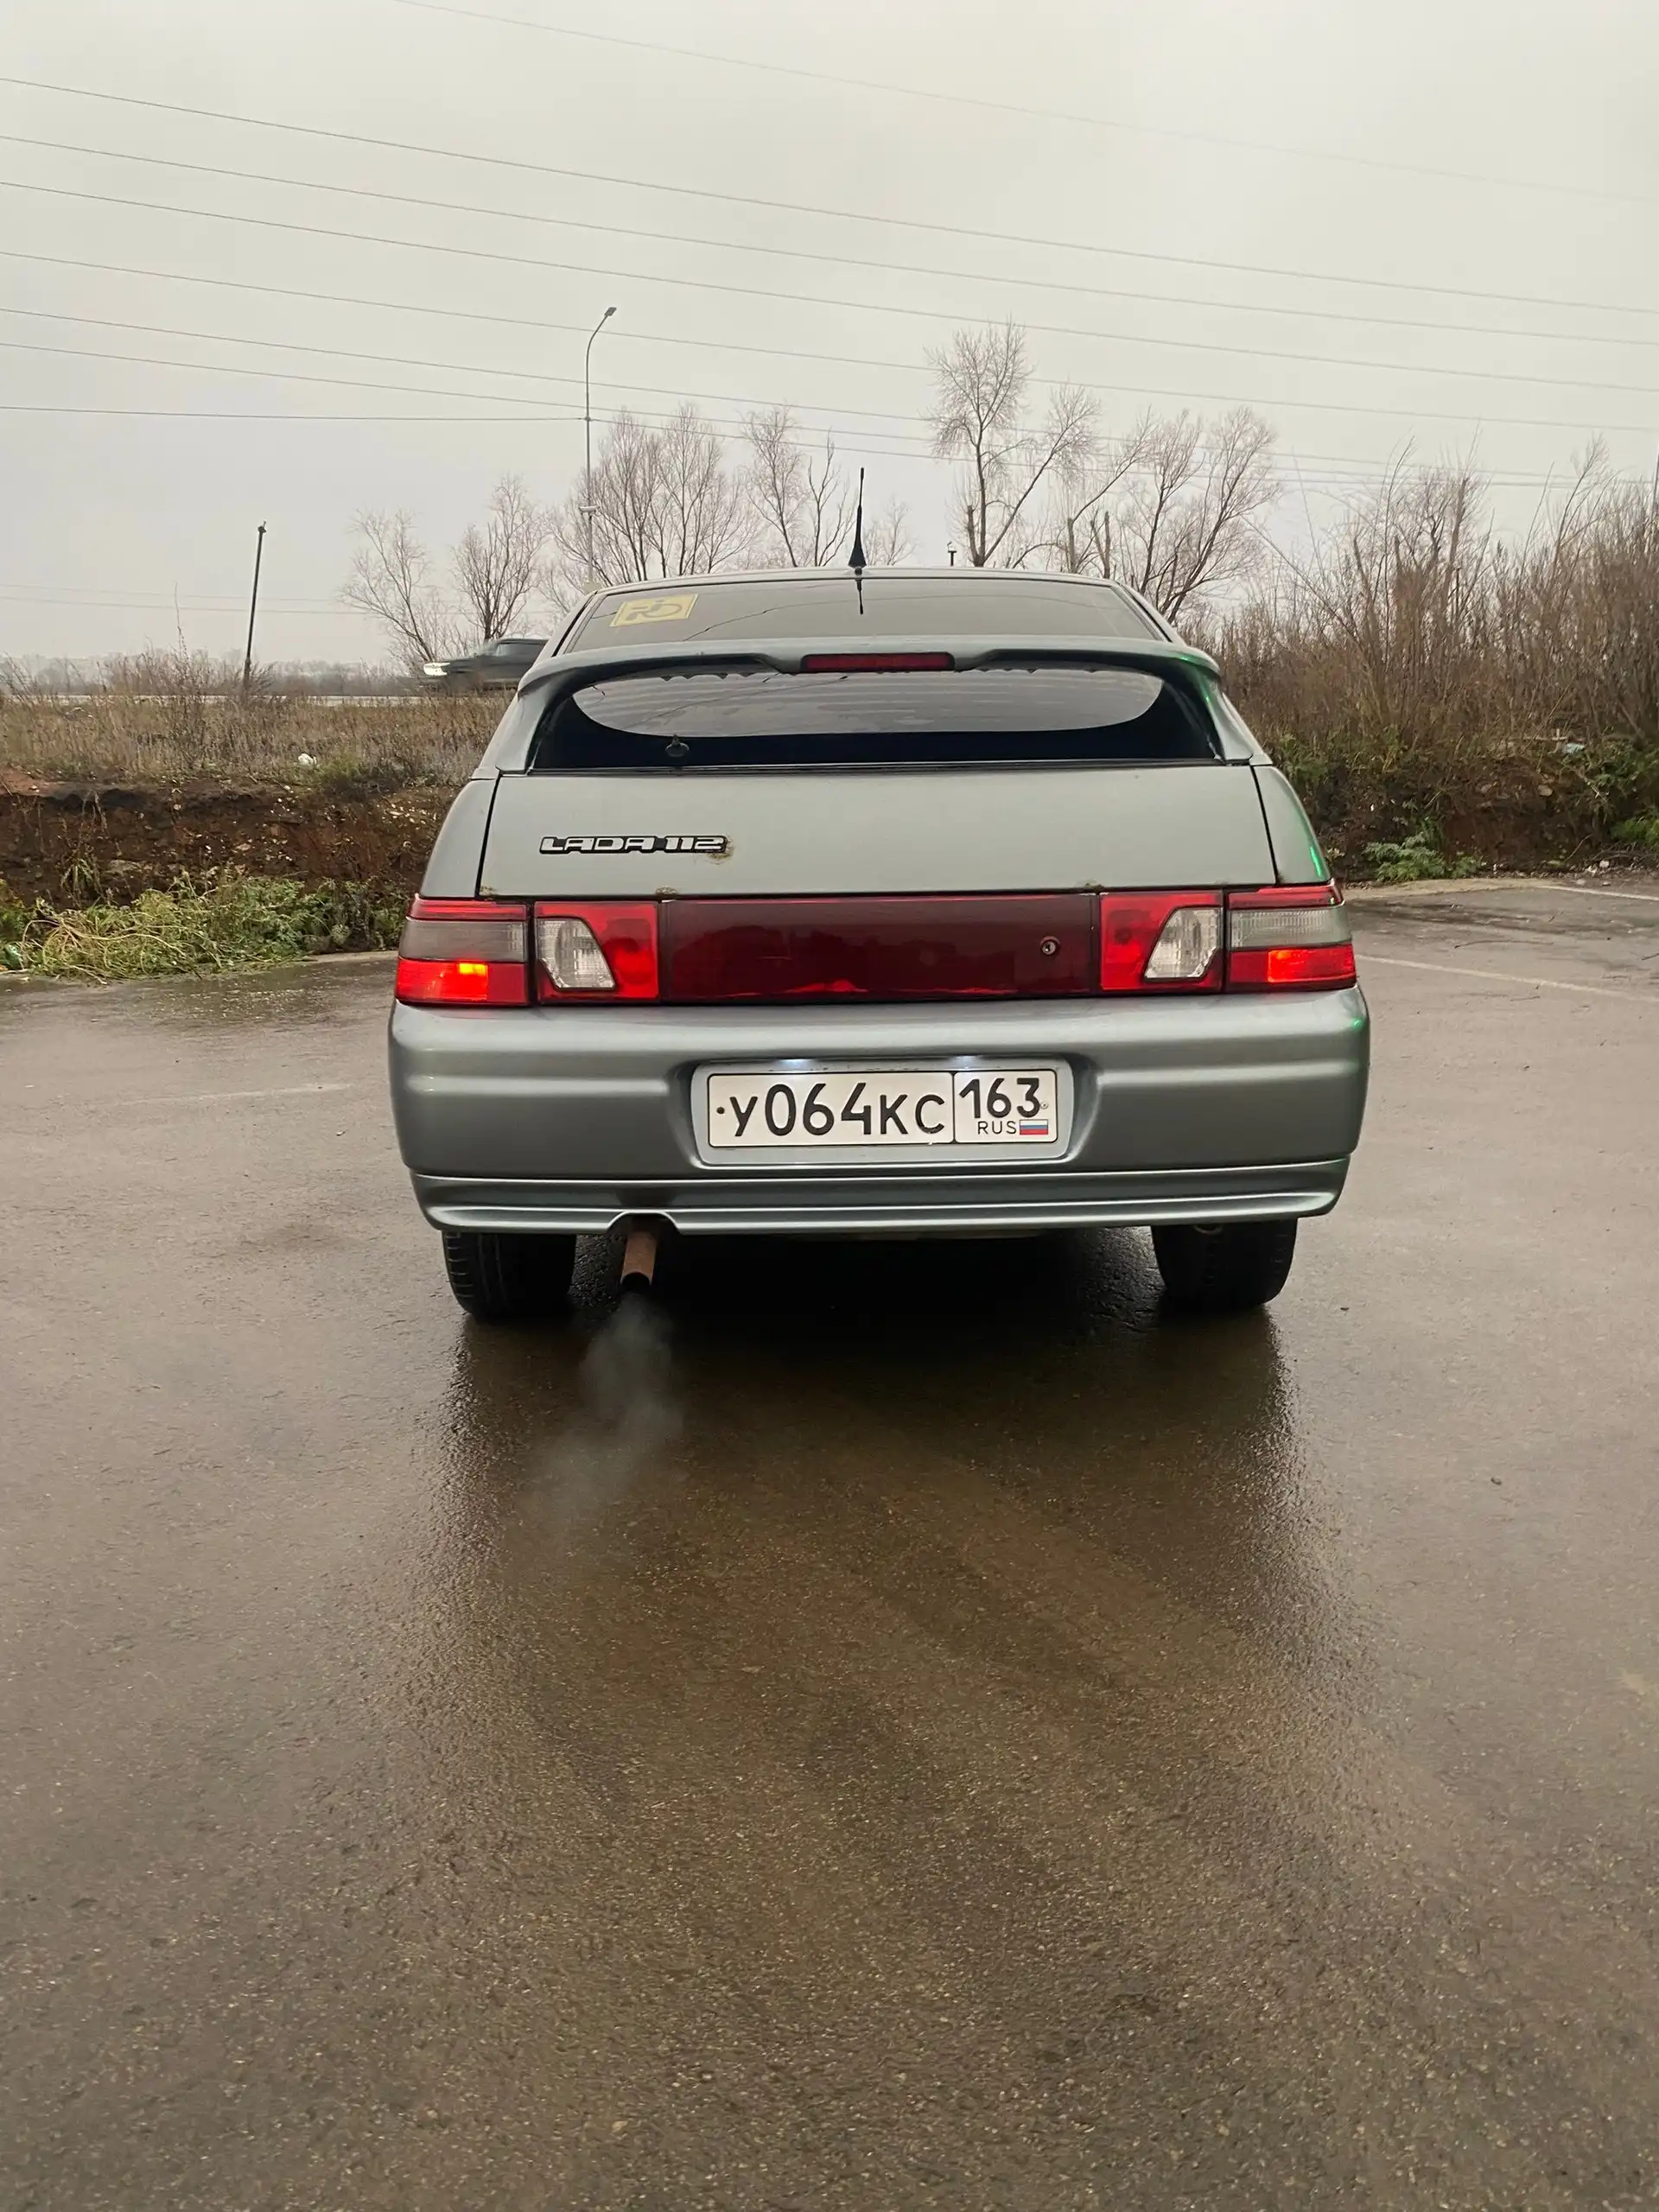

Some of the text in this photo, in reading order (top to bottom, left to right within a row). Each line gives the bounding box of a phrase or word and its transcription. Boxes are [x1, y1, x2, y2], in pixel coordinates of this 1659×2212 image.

[539, 836, 725, 852] LADA 112
[958, 1077, 1040, 1119] 163
[977, 1120, 1017, 1135] RUS
